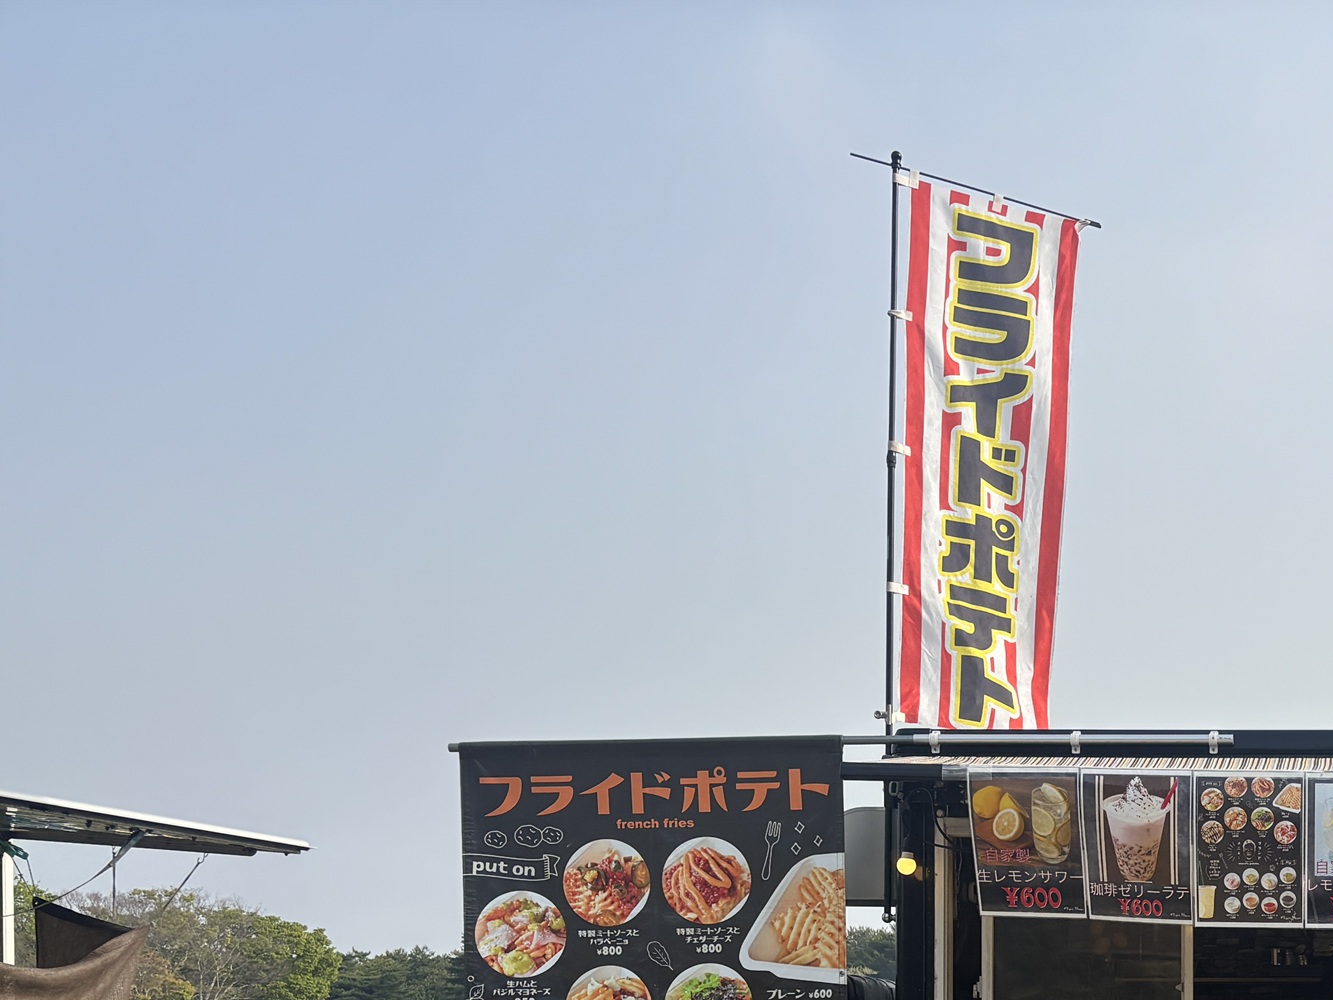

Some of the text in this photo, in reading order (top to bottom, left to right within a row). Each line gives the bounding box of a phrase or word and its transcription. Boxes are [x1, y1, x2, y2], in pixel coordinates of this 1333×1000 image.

[940, 208, 1037, 725] フライドポテト
[479, 766, 830, 818] フライドポテト
[616, 817, 695, 830] french fries
[984, 848, 1031, 863] 自家製
[471, 860, 536, 878] put on
[978, 869, 1084, 885] 生レモンサワー
[1001, 886, 1063, 910] ¥600
[1089, 883, 1190, 900] 珈琲ゼリーラテ
[1118, 898, 1163, 918] ¥600
[578, 929, 640, 938] 特製ミートソースと
[675, 927, 741, 936] 特製ミートソースと
[685, 935, 732, 944] チェダーチーズ
[596, 946, 622, 955] ¥800
[695, 944, 722, 953] ¥800
[507, 980, 537, 988] 生ハムと
[766, 988, 833, 1000] プレーン ¥600
